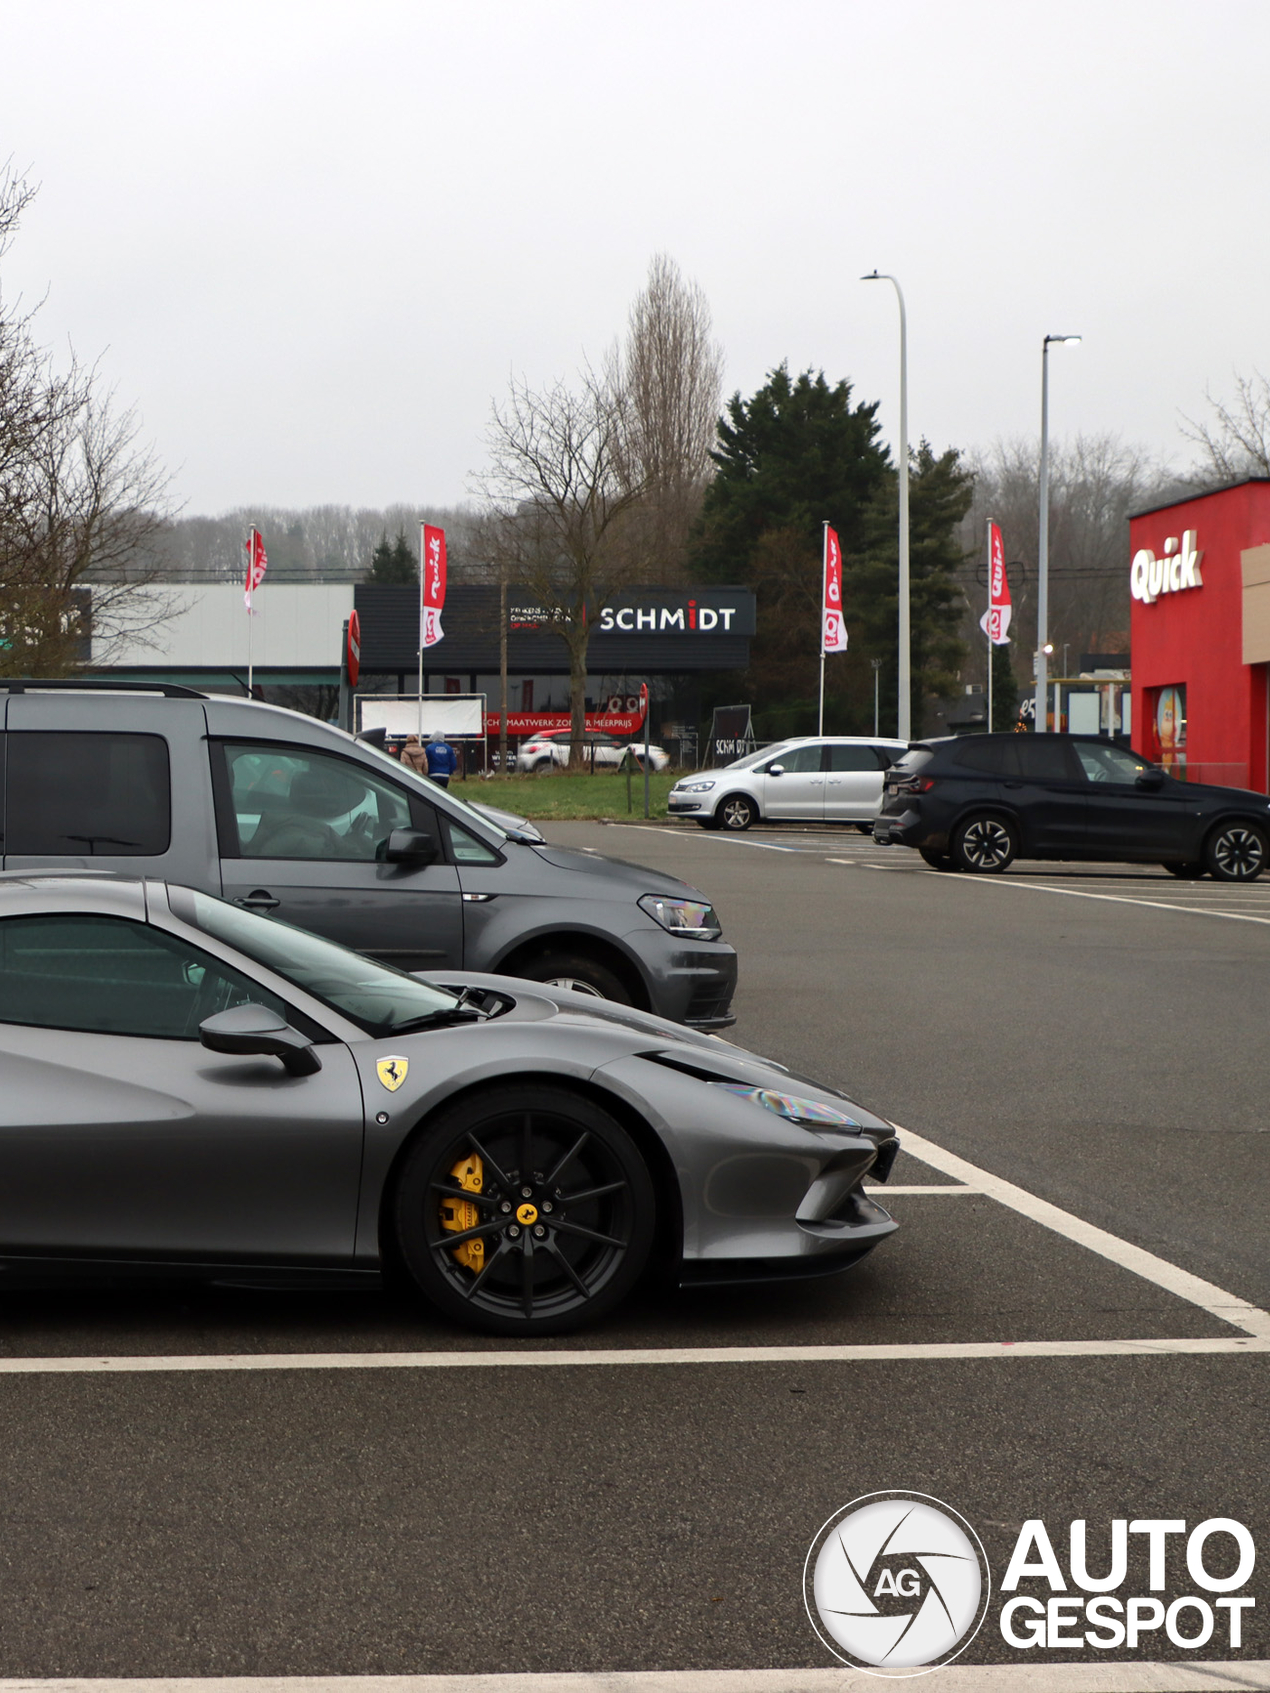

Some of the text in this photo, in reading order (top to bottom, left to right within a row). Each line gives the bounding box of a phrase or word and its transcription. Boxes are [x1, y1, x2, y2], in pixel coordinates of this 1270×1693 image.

[1130, 529, 1203, 604] Quick
[507, 718, 554, 728] MAATWERK
[593, 719, 633, 730] MEERPRIJS
